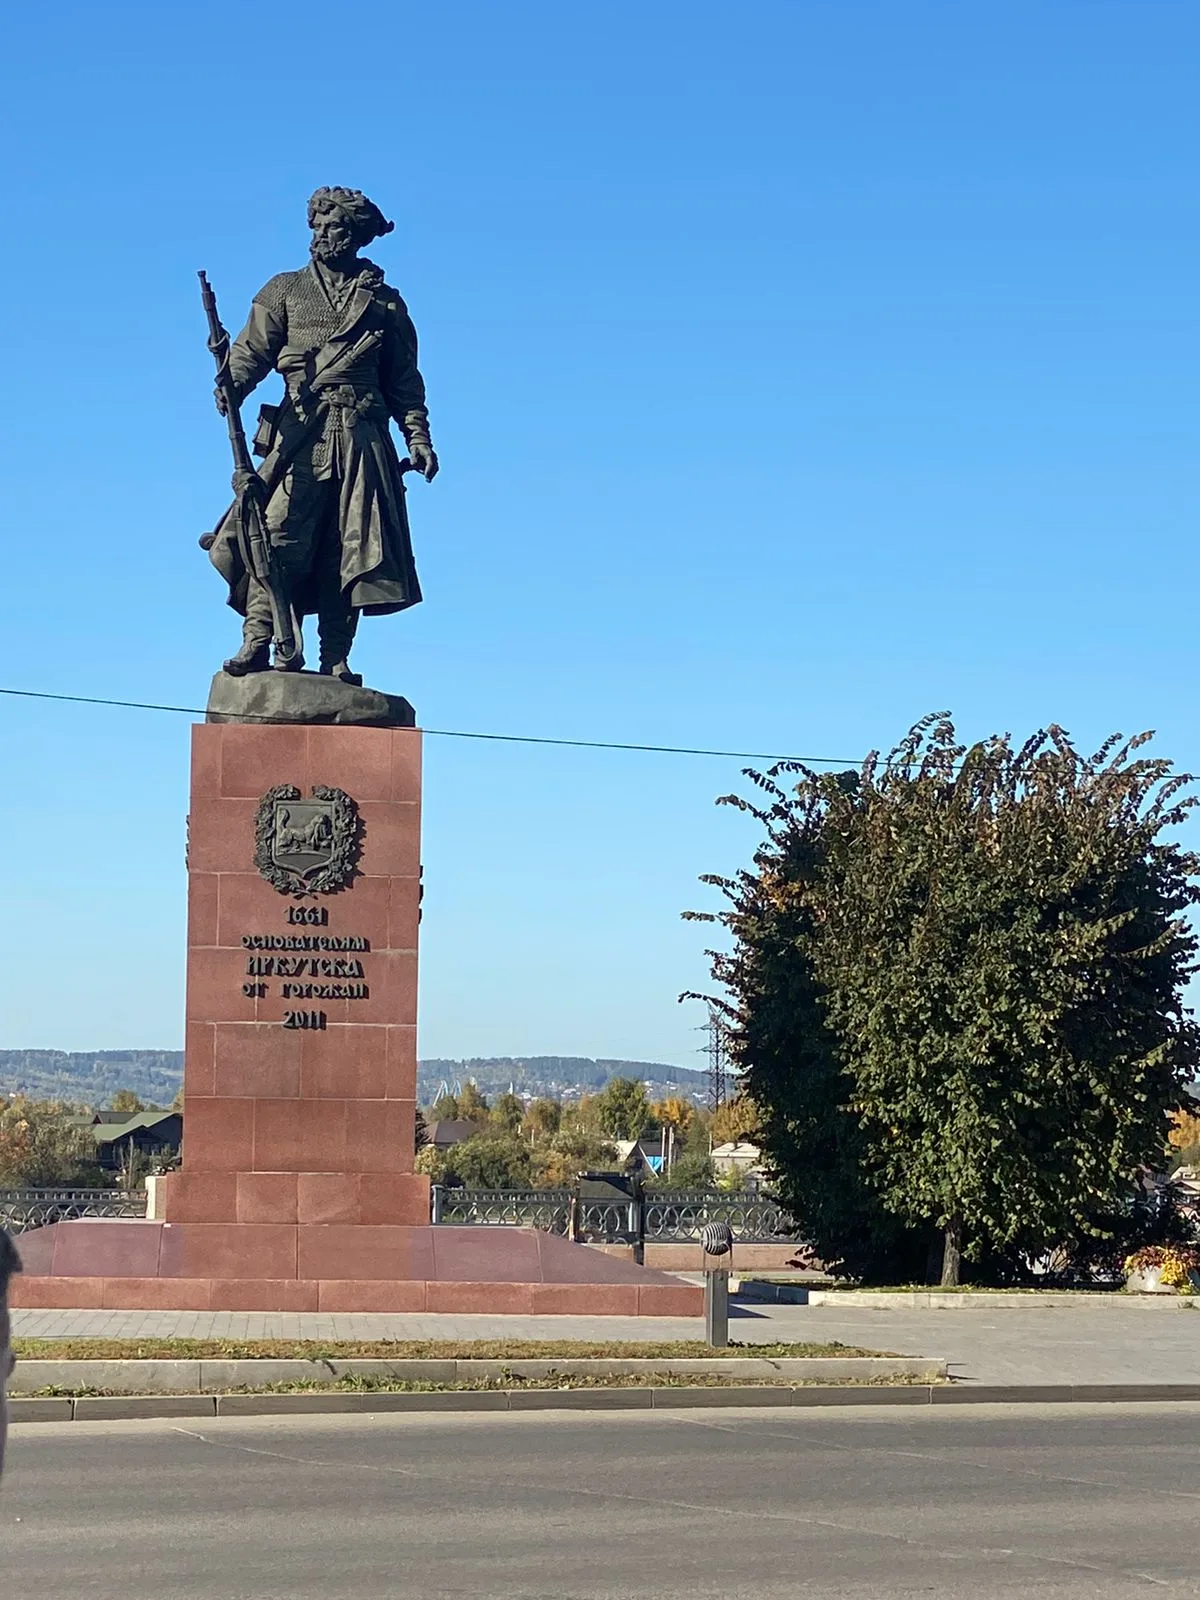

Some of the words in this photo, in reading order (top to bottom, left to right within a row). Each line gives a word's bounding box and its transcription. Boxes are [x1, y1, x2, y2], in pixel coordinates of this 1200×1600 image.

[285, 906, 326, 925] 1661
[247, 957, 363, 977] ИРКУТСКА
[282, 983, 367, 998] ГОРОЖАН
[283, 1010, 325, 1029] 2011
